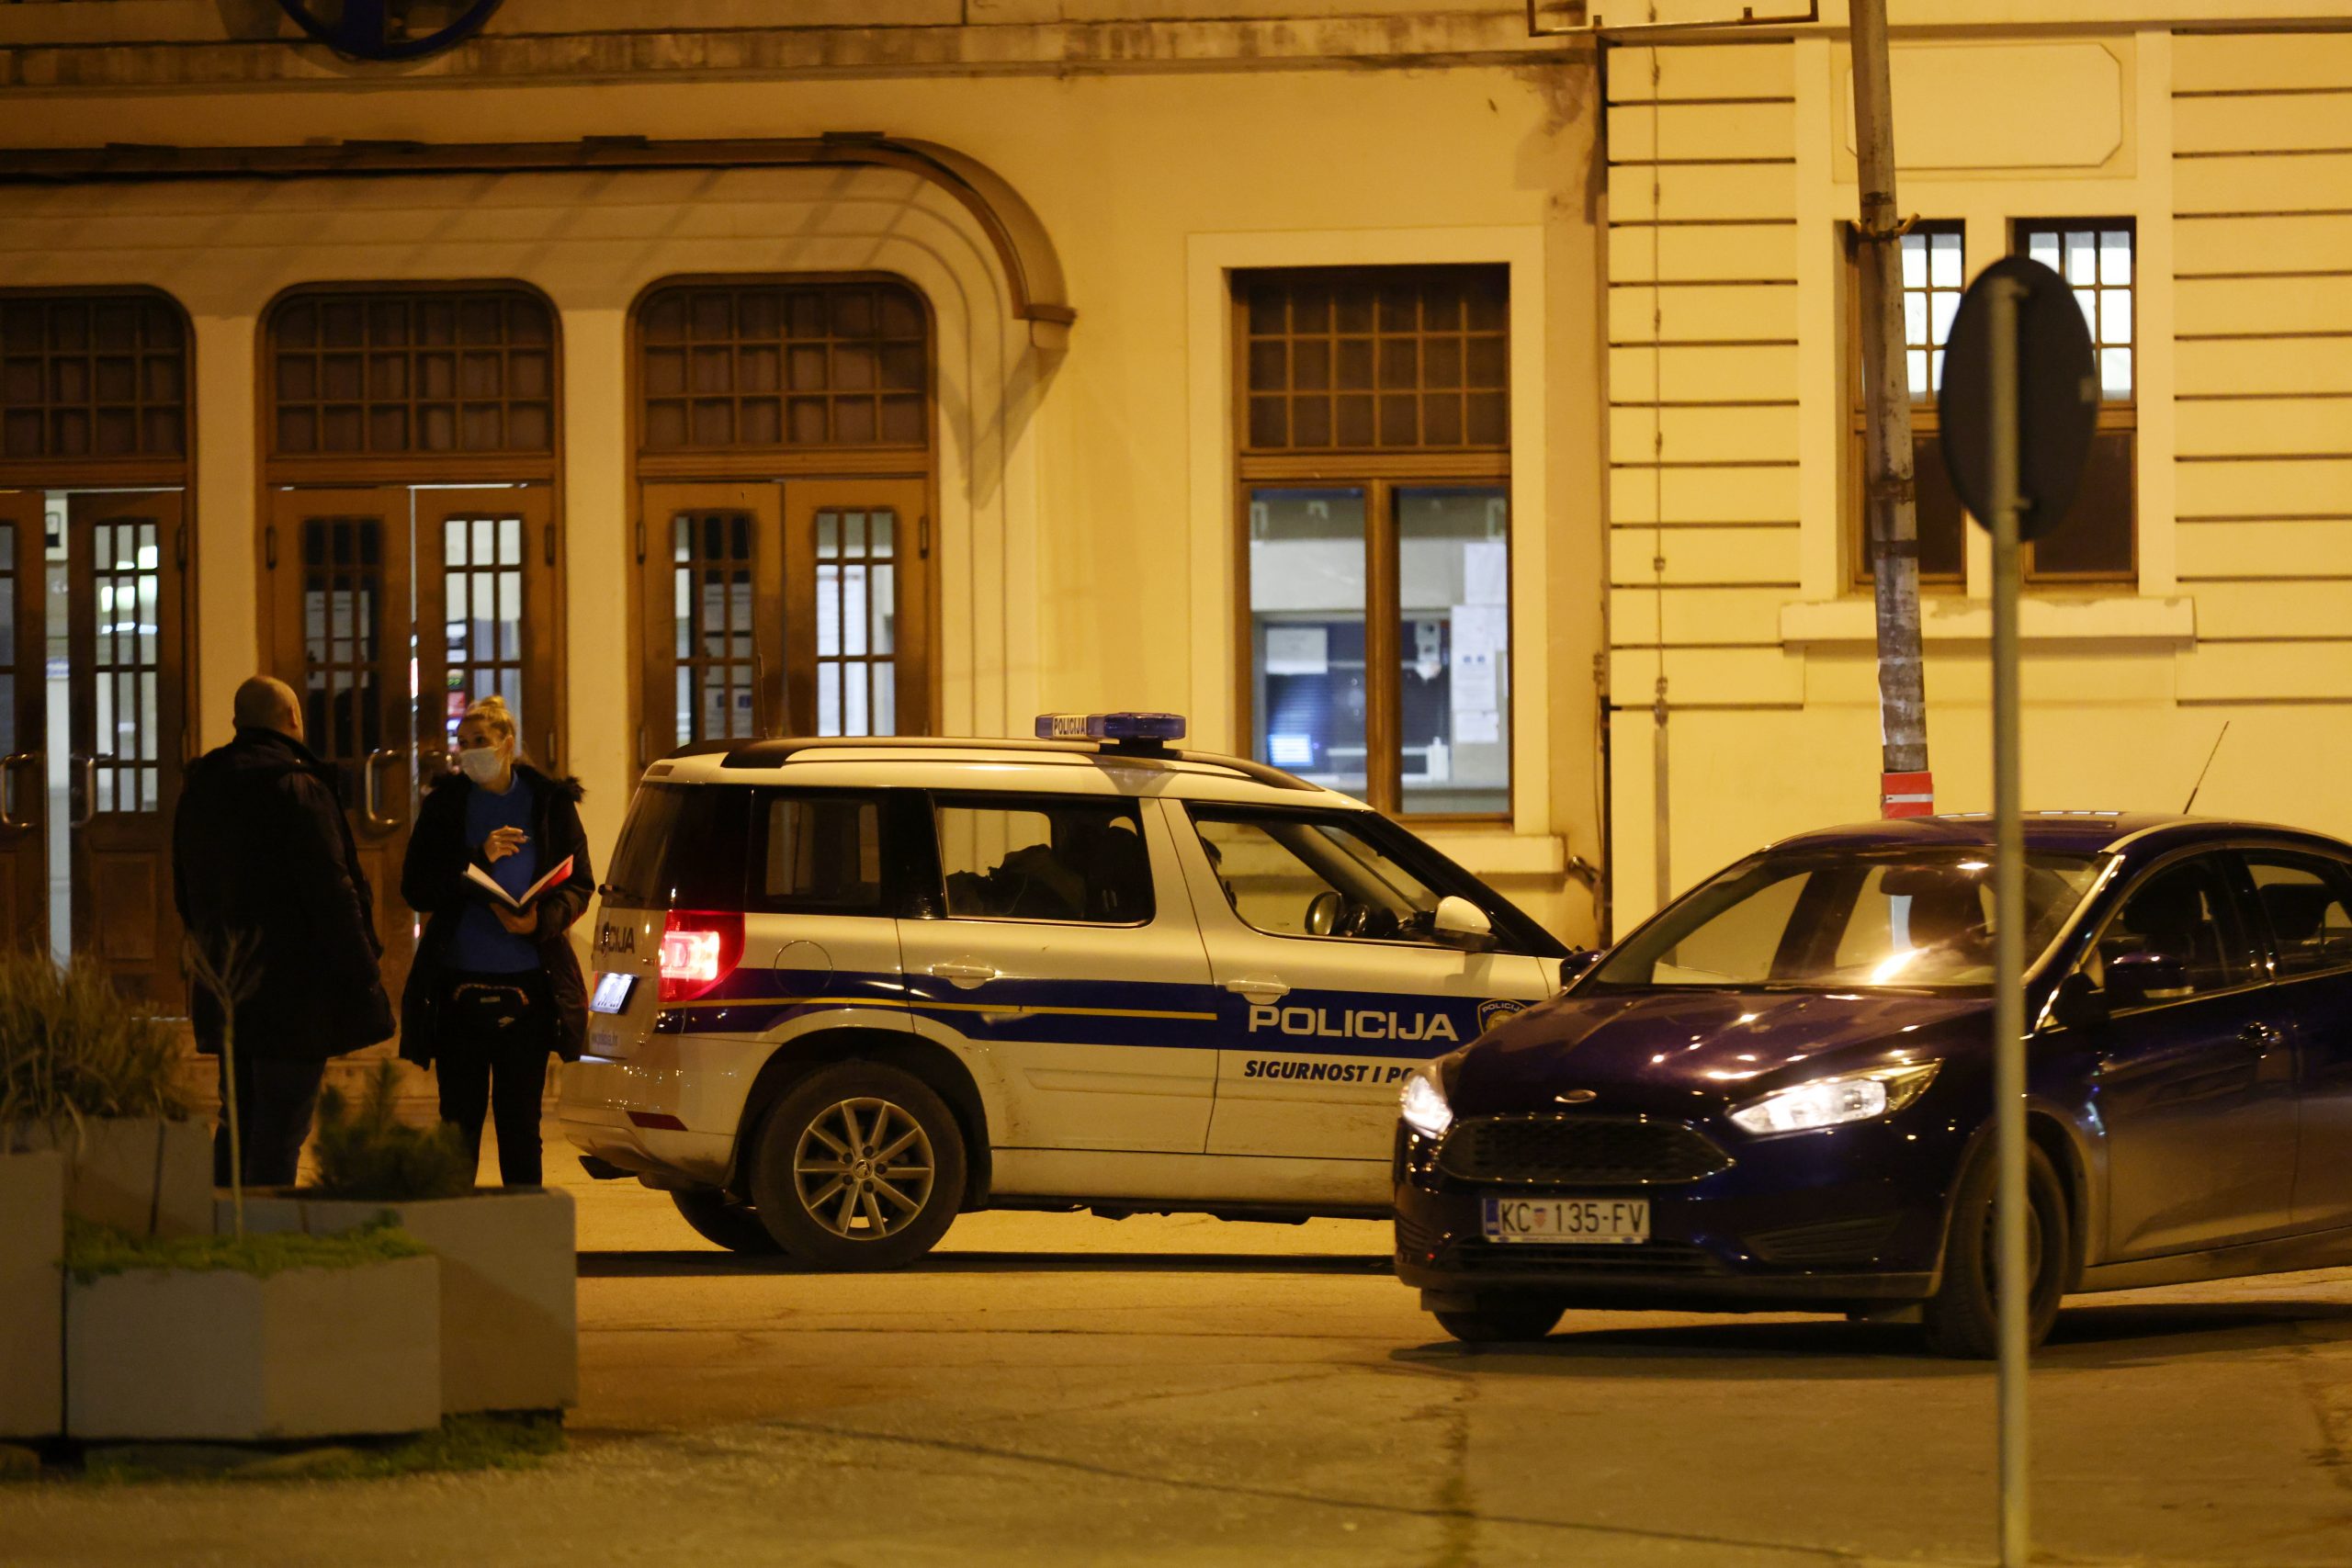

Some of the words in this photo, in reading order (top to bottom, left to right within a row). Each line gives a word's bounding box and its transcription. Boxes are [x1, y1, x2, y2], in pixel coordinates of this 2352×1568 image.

[1054, 716, 1086, 736] POLICIJA
[1482, 1002, 1521, 1013] POLICIJ
[1248, 1005, 1458, 1042] POLICIJA
[1244, 1060, 1368, 1082] SIGURNOST
[1372, 1066, 1382, 1083] I
[1385, 1066, 1416, 1084] PO
[1500, 1202, 1532, 1233] KC
[1555, 1203, 1644, 1233] 135-FV
